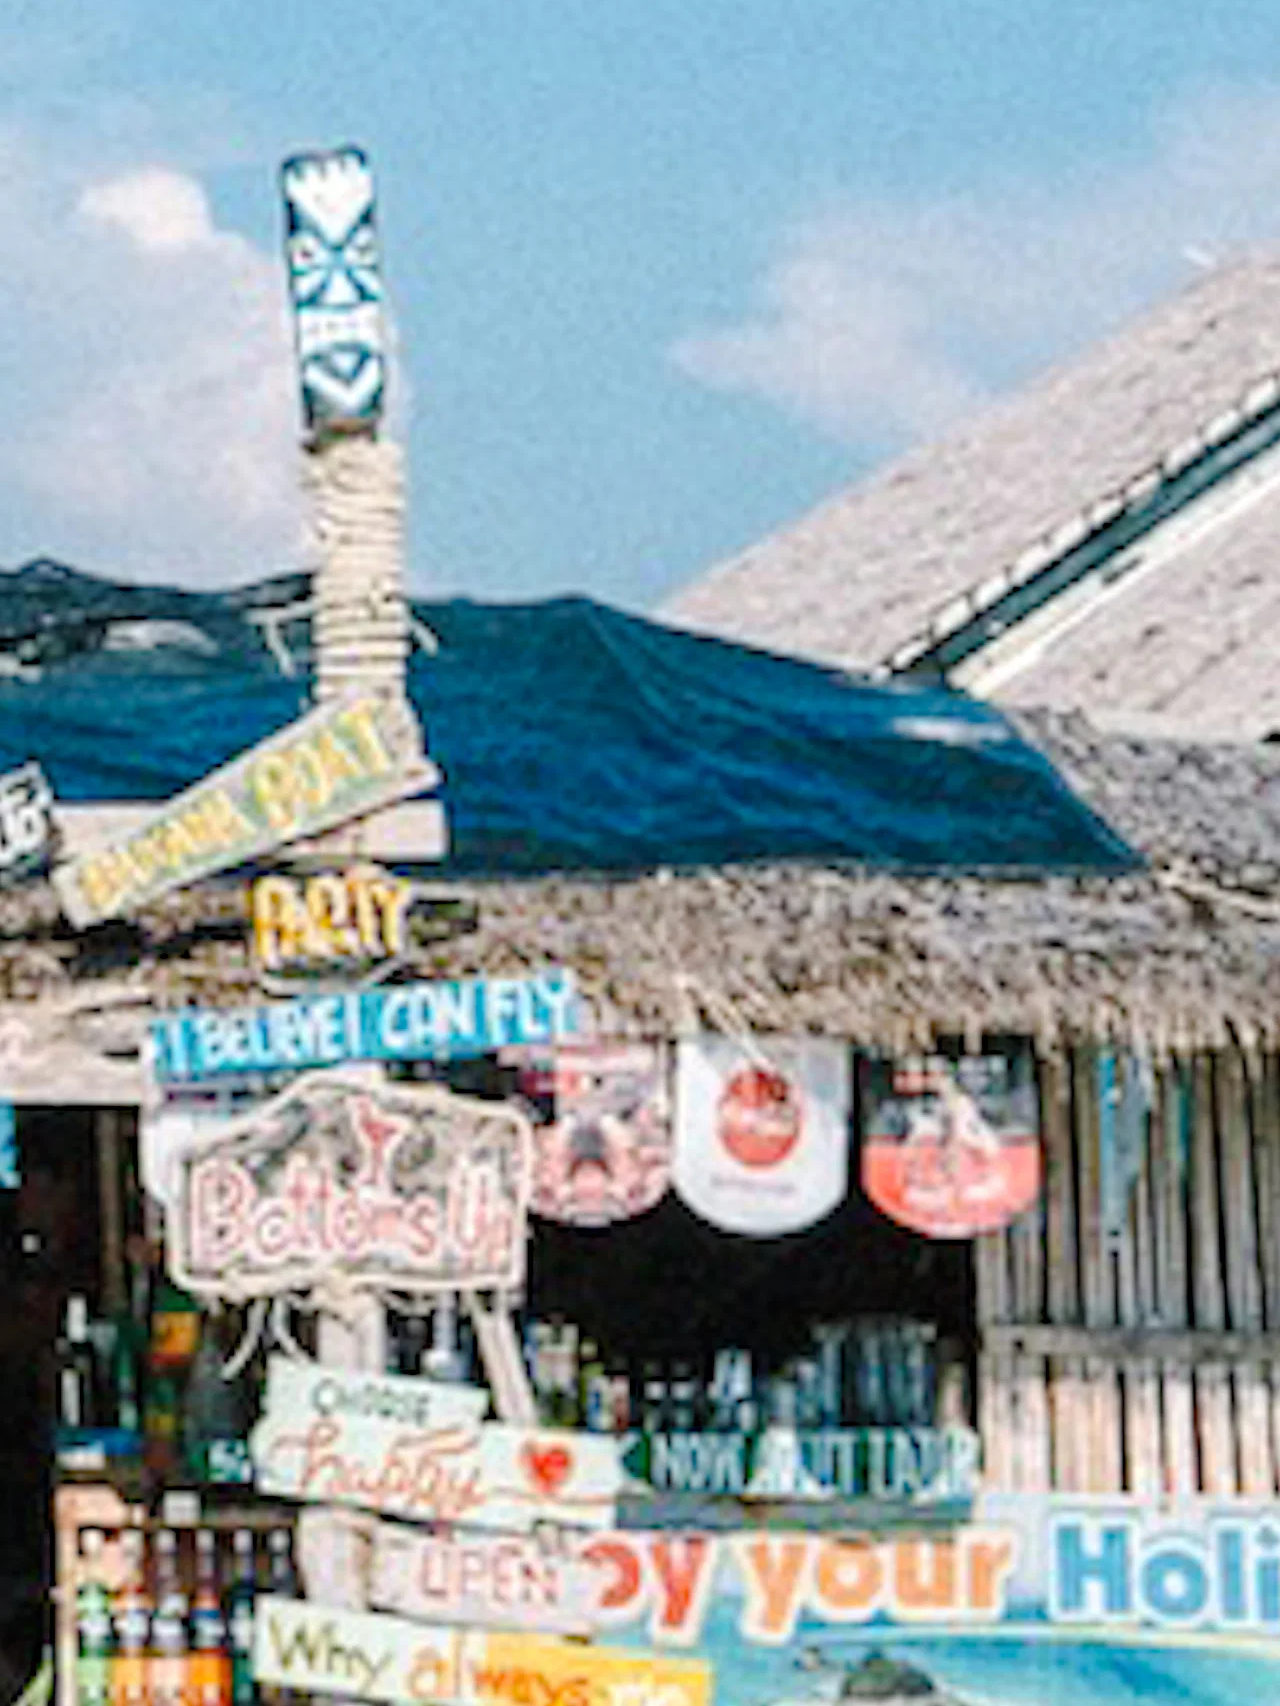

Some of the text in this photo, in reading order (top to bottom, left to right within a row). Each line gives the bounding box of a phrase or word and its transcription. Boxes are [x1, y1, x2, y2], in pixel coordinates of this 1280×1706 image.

[381, 983, 474, 1047] CAN
[491, 973, 577, 1041] FLY
[754, 1535, 1012, 1633] your
[268, 1614, 394, 1686] Why
